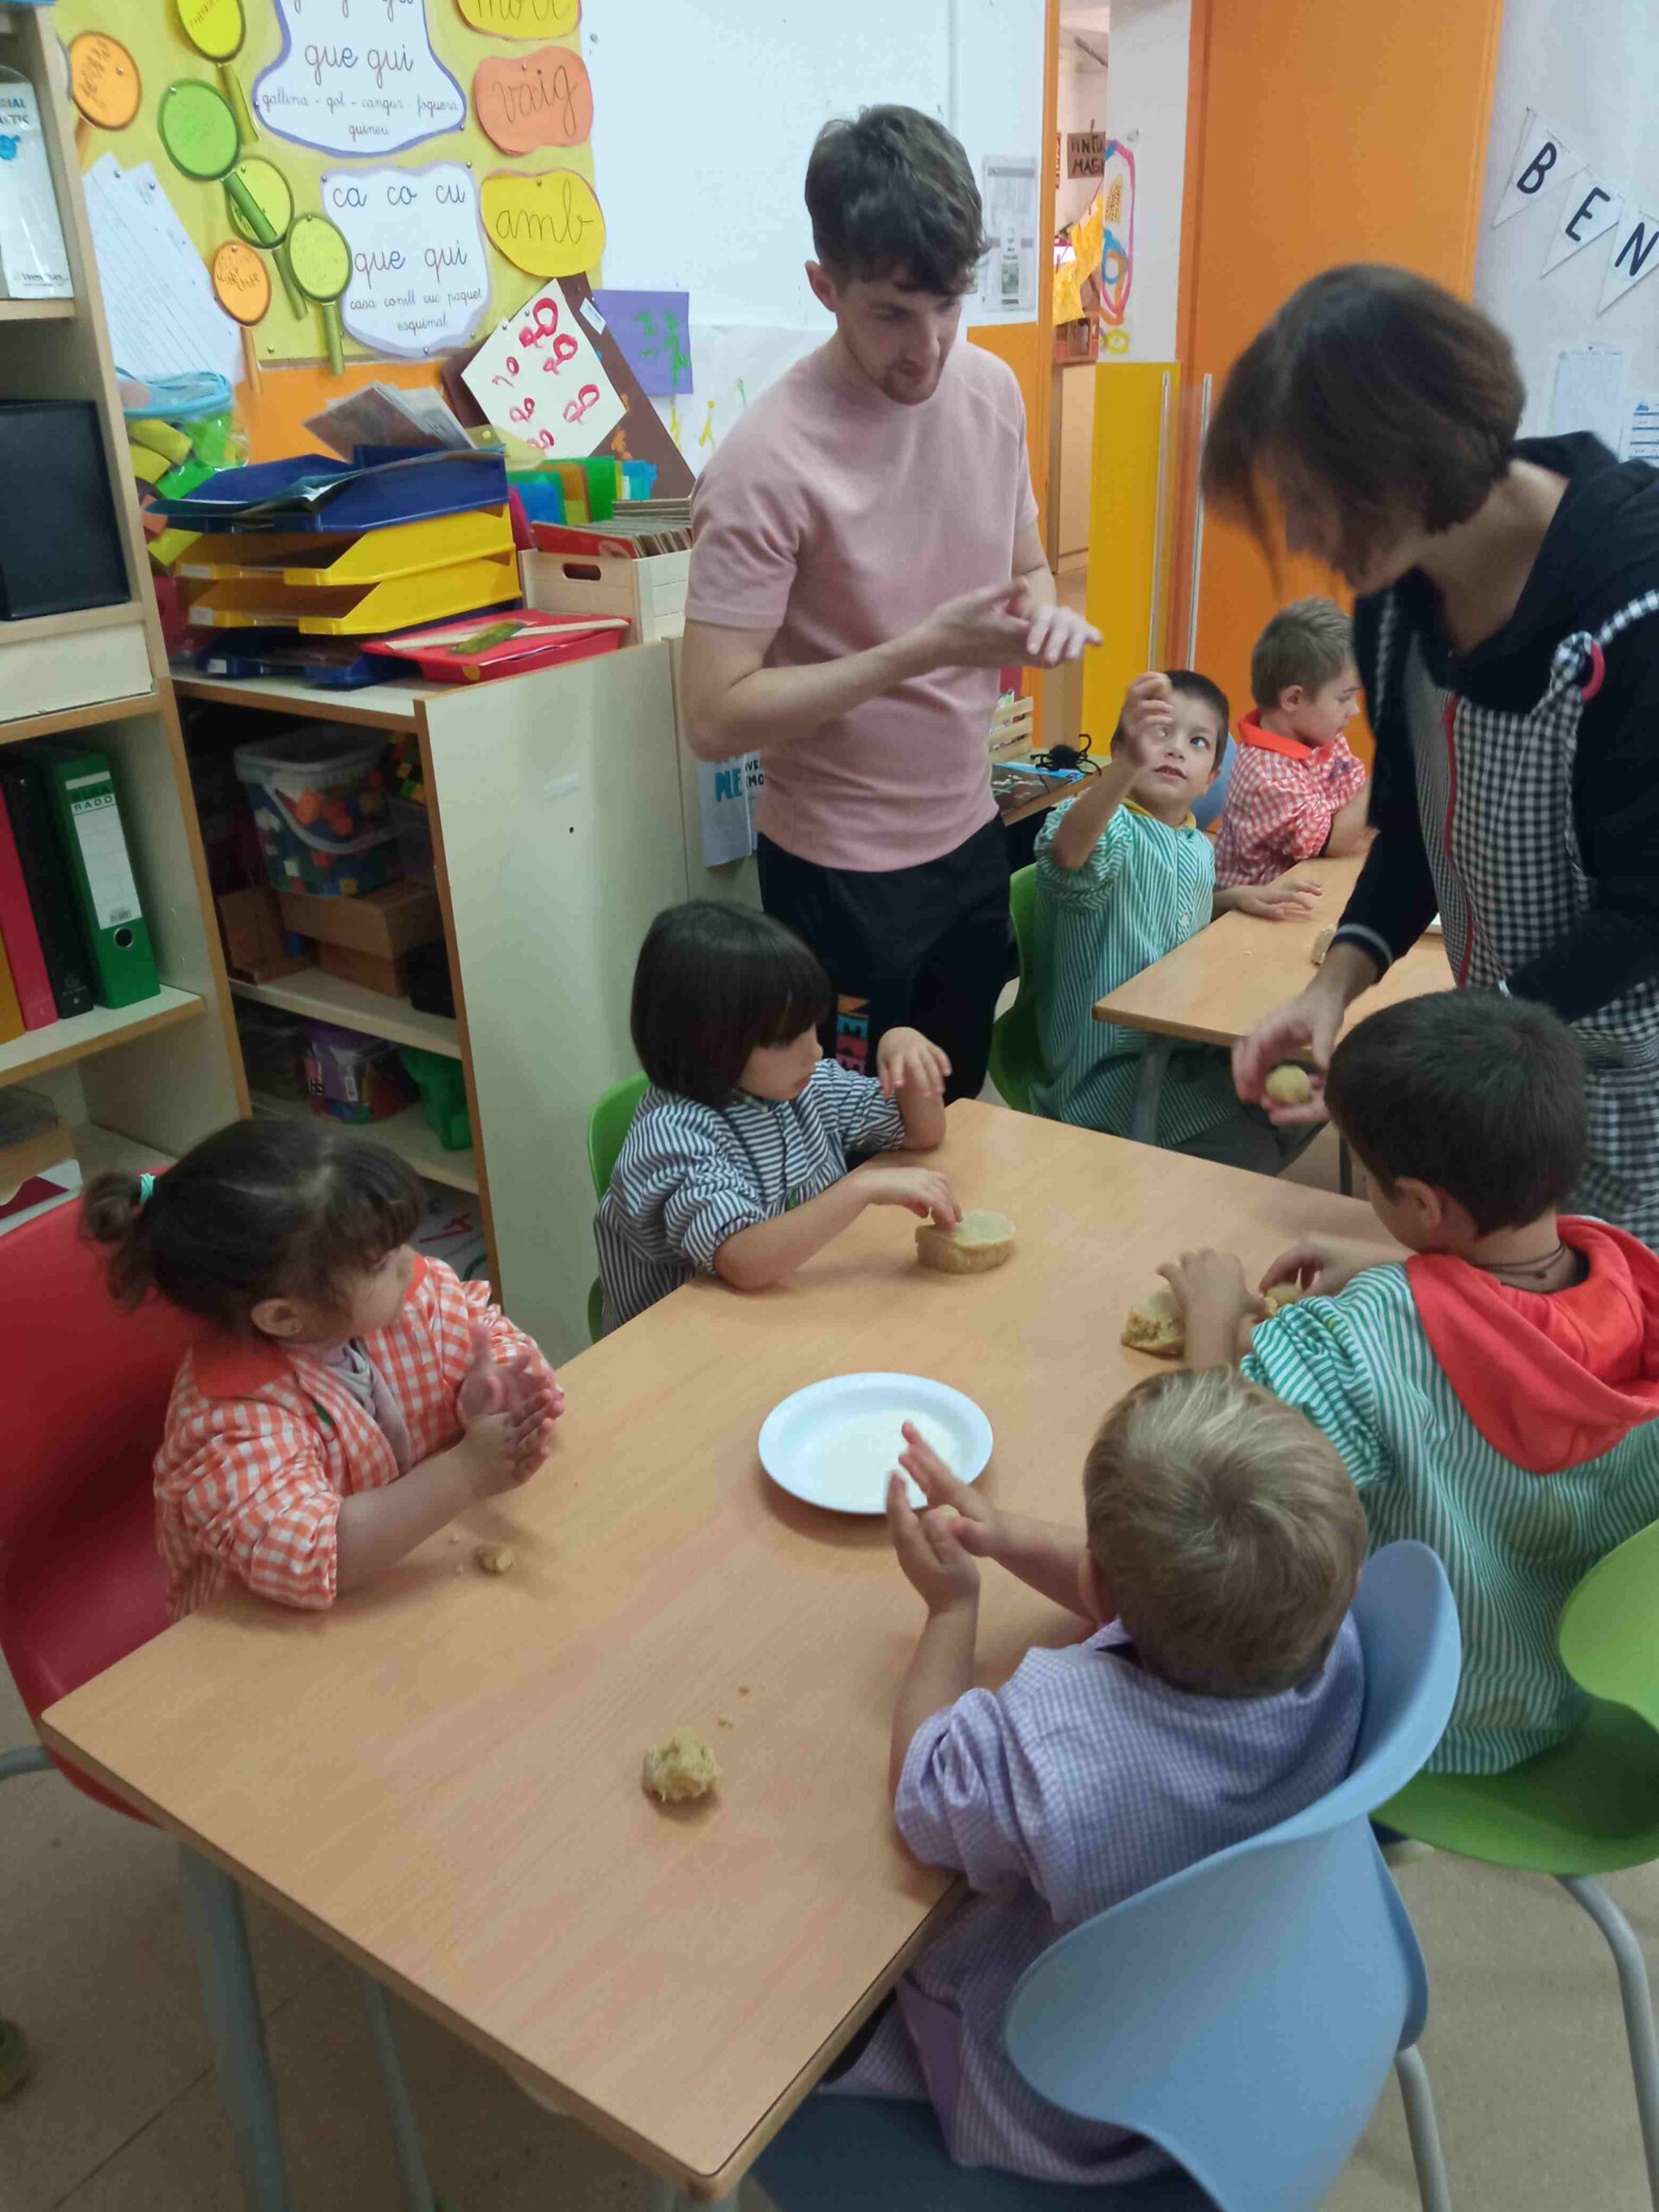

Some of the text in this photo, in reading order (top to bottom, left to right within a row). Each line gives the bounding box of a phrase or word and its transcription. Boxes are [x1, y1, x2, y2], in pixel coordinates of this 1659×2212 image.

[262, 87, 309, 113] gallina
[493, 64, 578, 138] vaig
[333, 184, 466, 208] ca co cu
[1516, 141, 1659, 276] BEN
[495, 178, 594, 244] amb
[354, 240, 467, 289] que qui
[350, 299, 376, 310] casa
[384, 289, 415, 307] conill
[448, 288, 482, 308] paquet
[397, 312, 448, 335] esquimal
[73, 794, 113, 812] RADO
